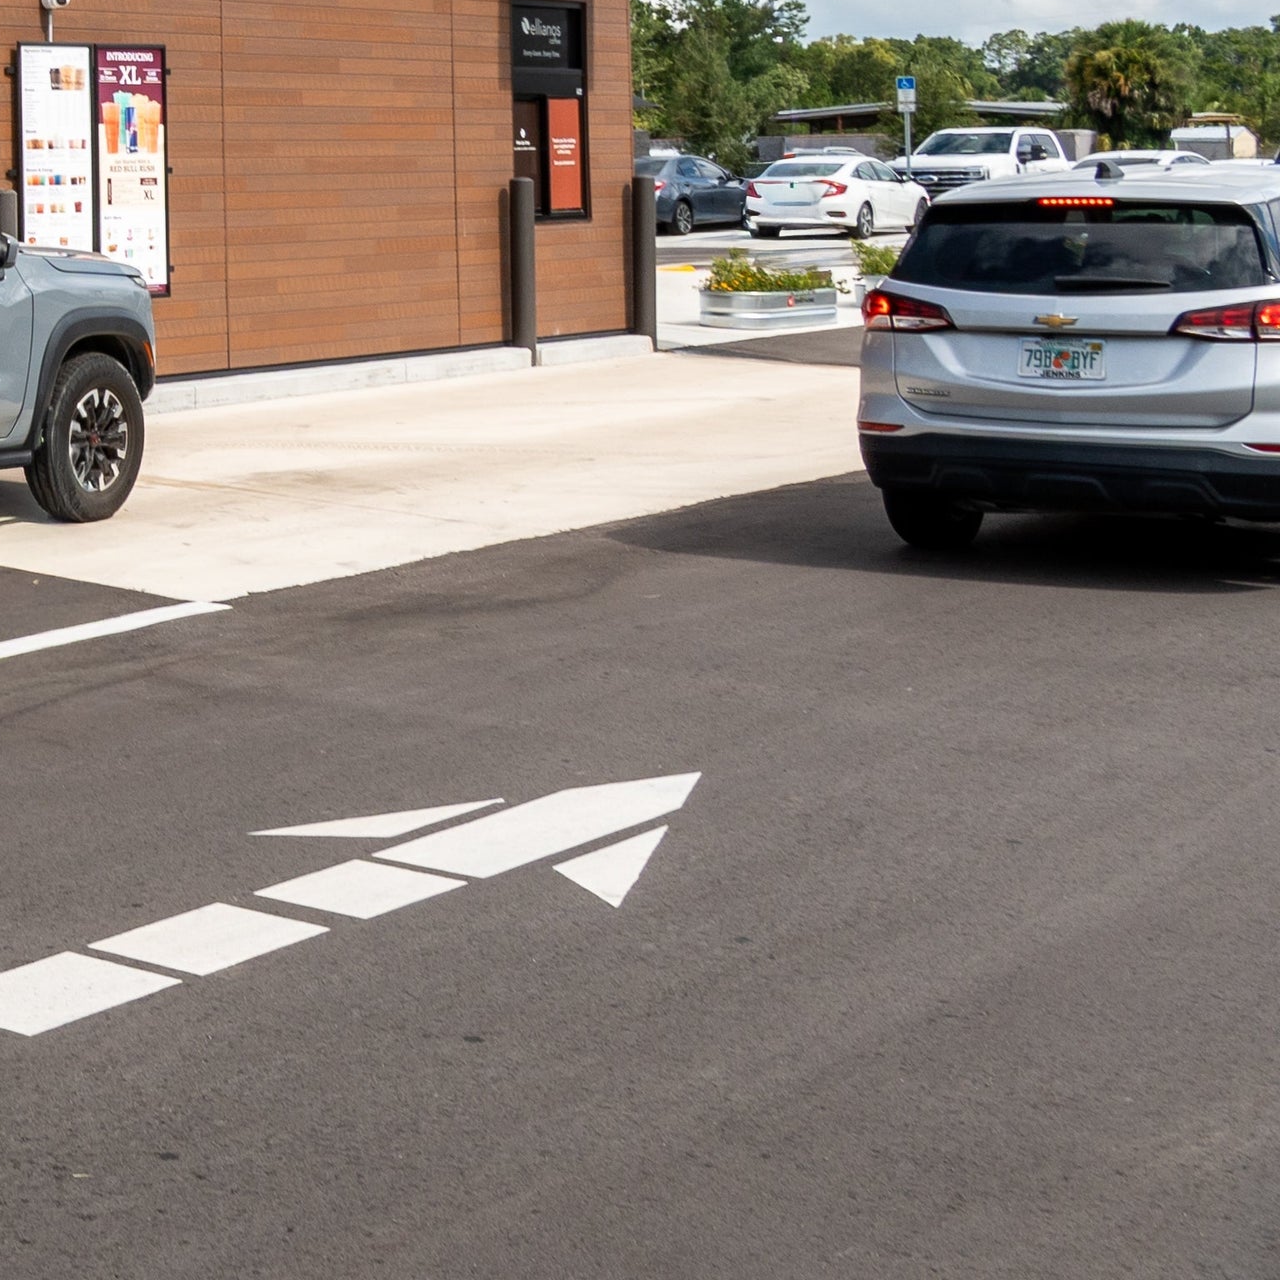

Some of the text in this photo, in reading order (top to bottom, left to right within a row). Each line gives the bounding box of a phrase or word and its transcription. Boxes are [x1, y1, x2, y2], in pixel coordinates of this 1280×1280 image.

[106, 51, 154, 62] INTRODUCING
[119, 65, 142, 85] XL
[143, 189, 155, 200] XL
[1040, 369, 1081, 379] JENKINS
